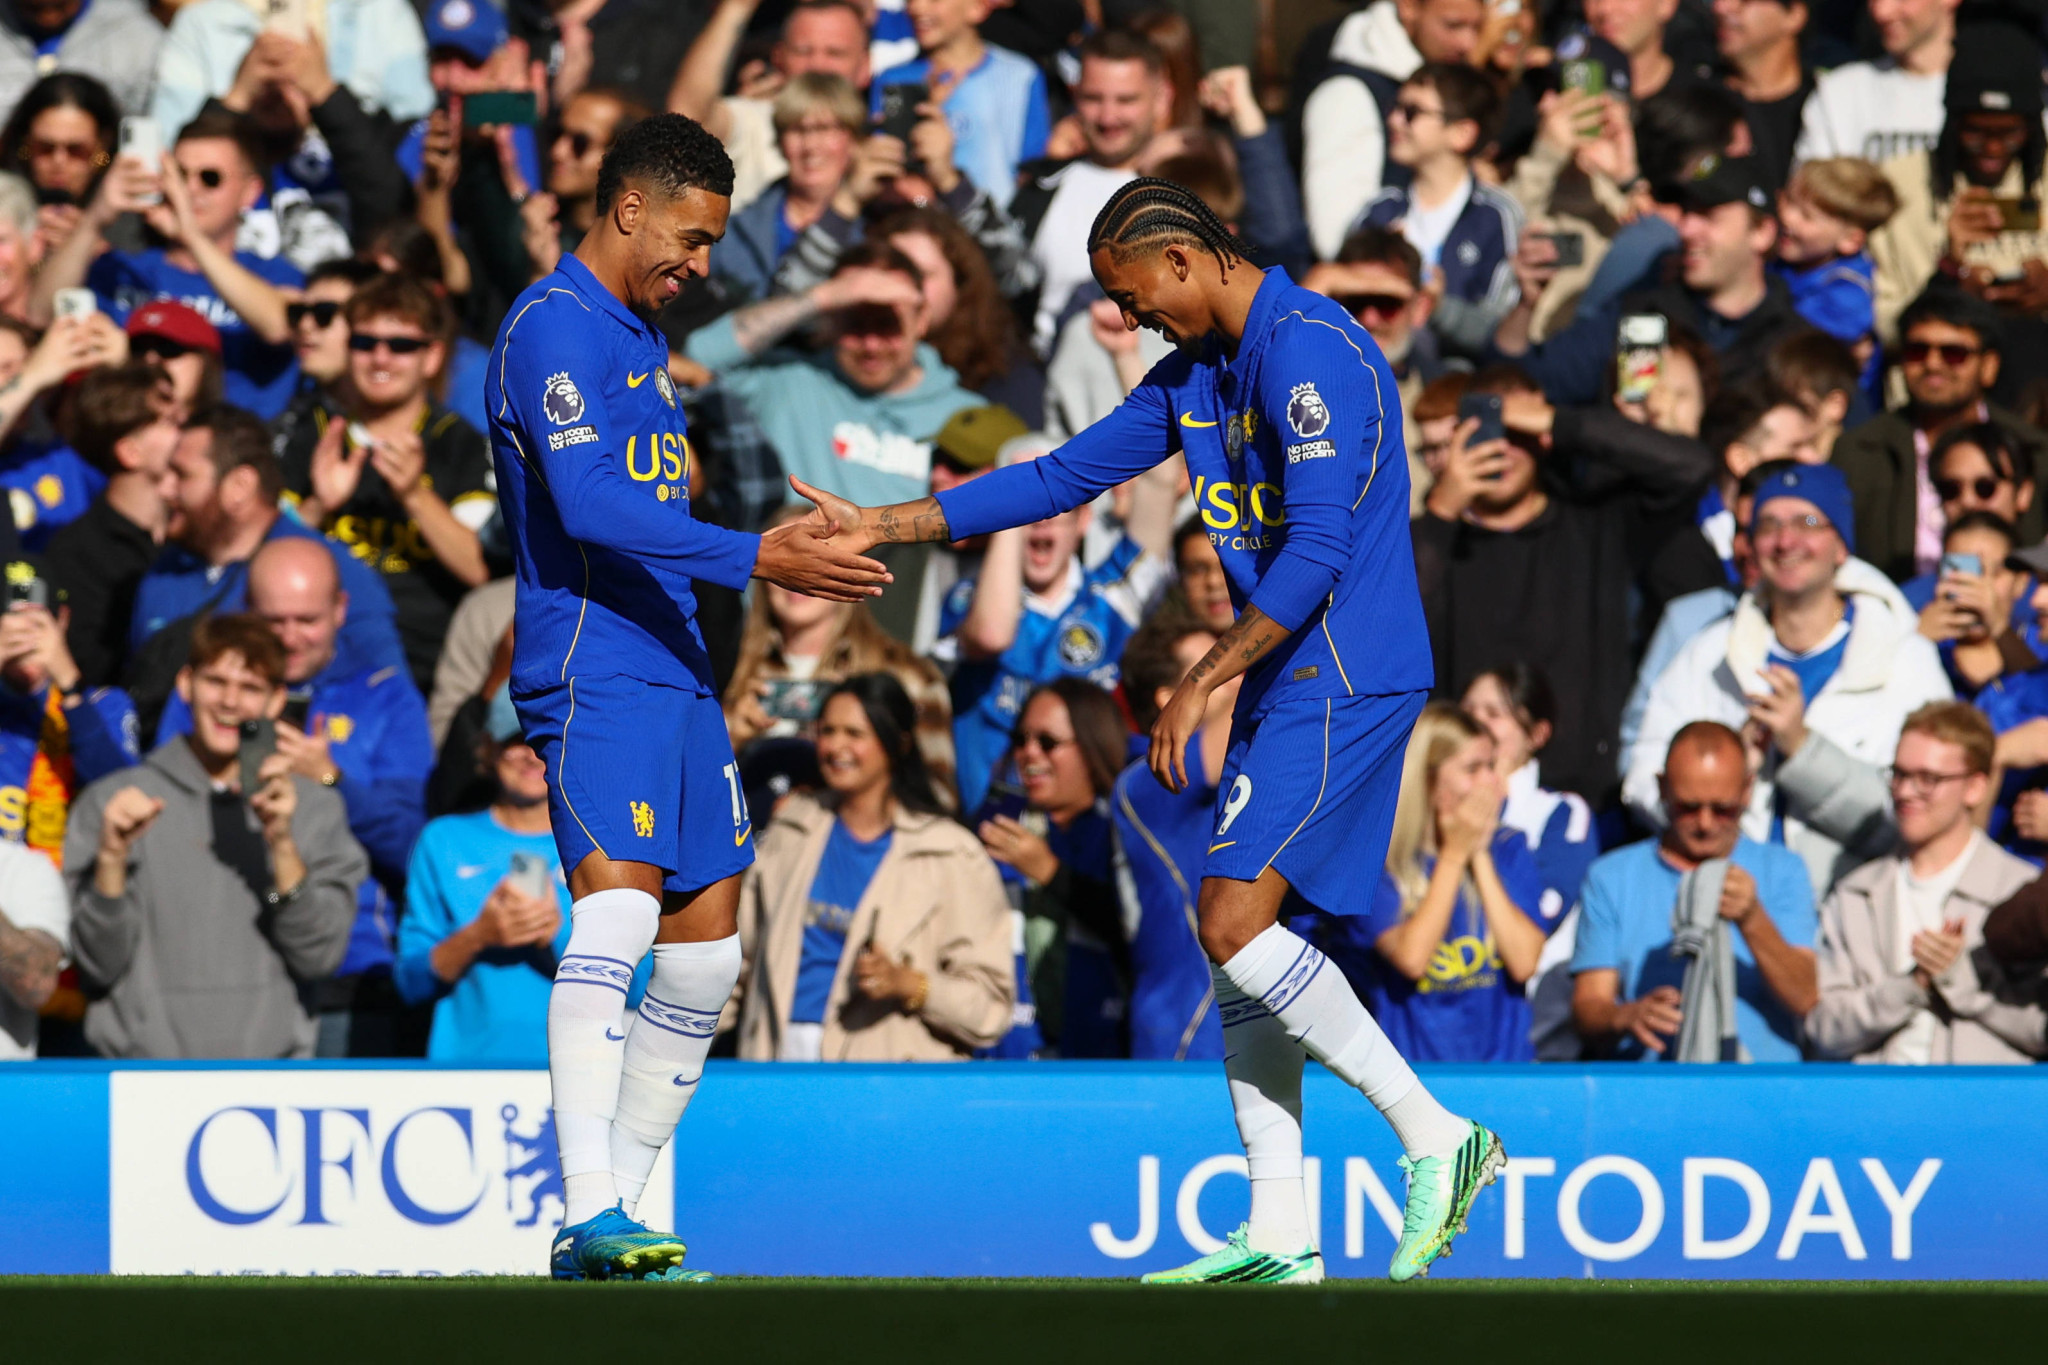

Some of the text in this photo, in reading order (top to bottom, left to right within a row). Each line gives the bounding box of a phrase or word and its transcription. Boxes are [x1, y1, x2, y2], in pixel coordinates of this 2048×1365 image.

[548, 426, 593, 444] No room
[549, 434, 599, 452] for racism
[626, 432, 690, 481] USD
[1287, 440, 1331, 456] No room
[1288, 448, 1336, 465] for racism
[1209, 532, 1229, 547] BY
[1217, 773, 1253, 835] 9
[185, 1105, 492, 1226] CFC
[1496, 1154, 1944, 1262] TODAY
